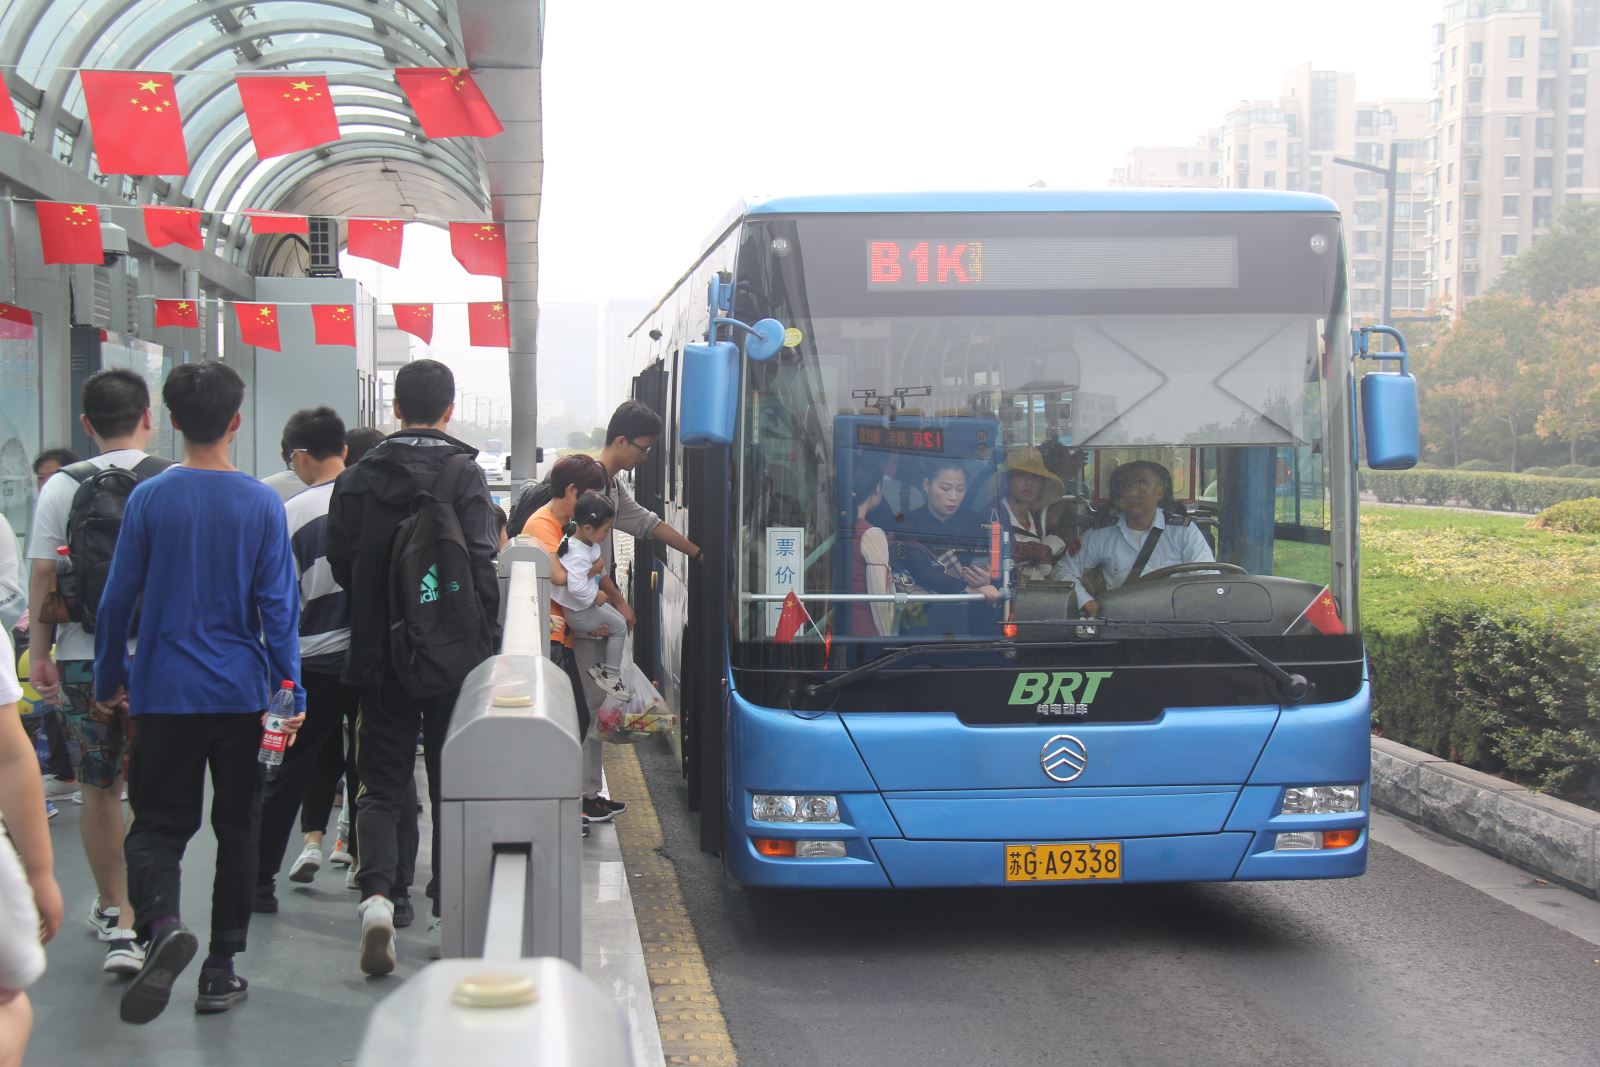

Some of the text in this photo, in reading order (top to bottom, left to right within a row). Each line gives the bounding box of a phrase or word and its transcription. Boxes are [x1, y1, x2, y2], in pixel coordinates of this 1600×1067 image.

[1007, 671, 1114, 705] BRT
[1036, 703, 1088, 715] 纯电动车
[1009, 849, 1117, 876] 苏G·A9338
